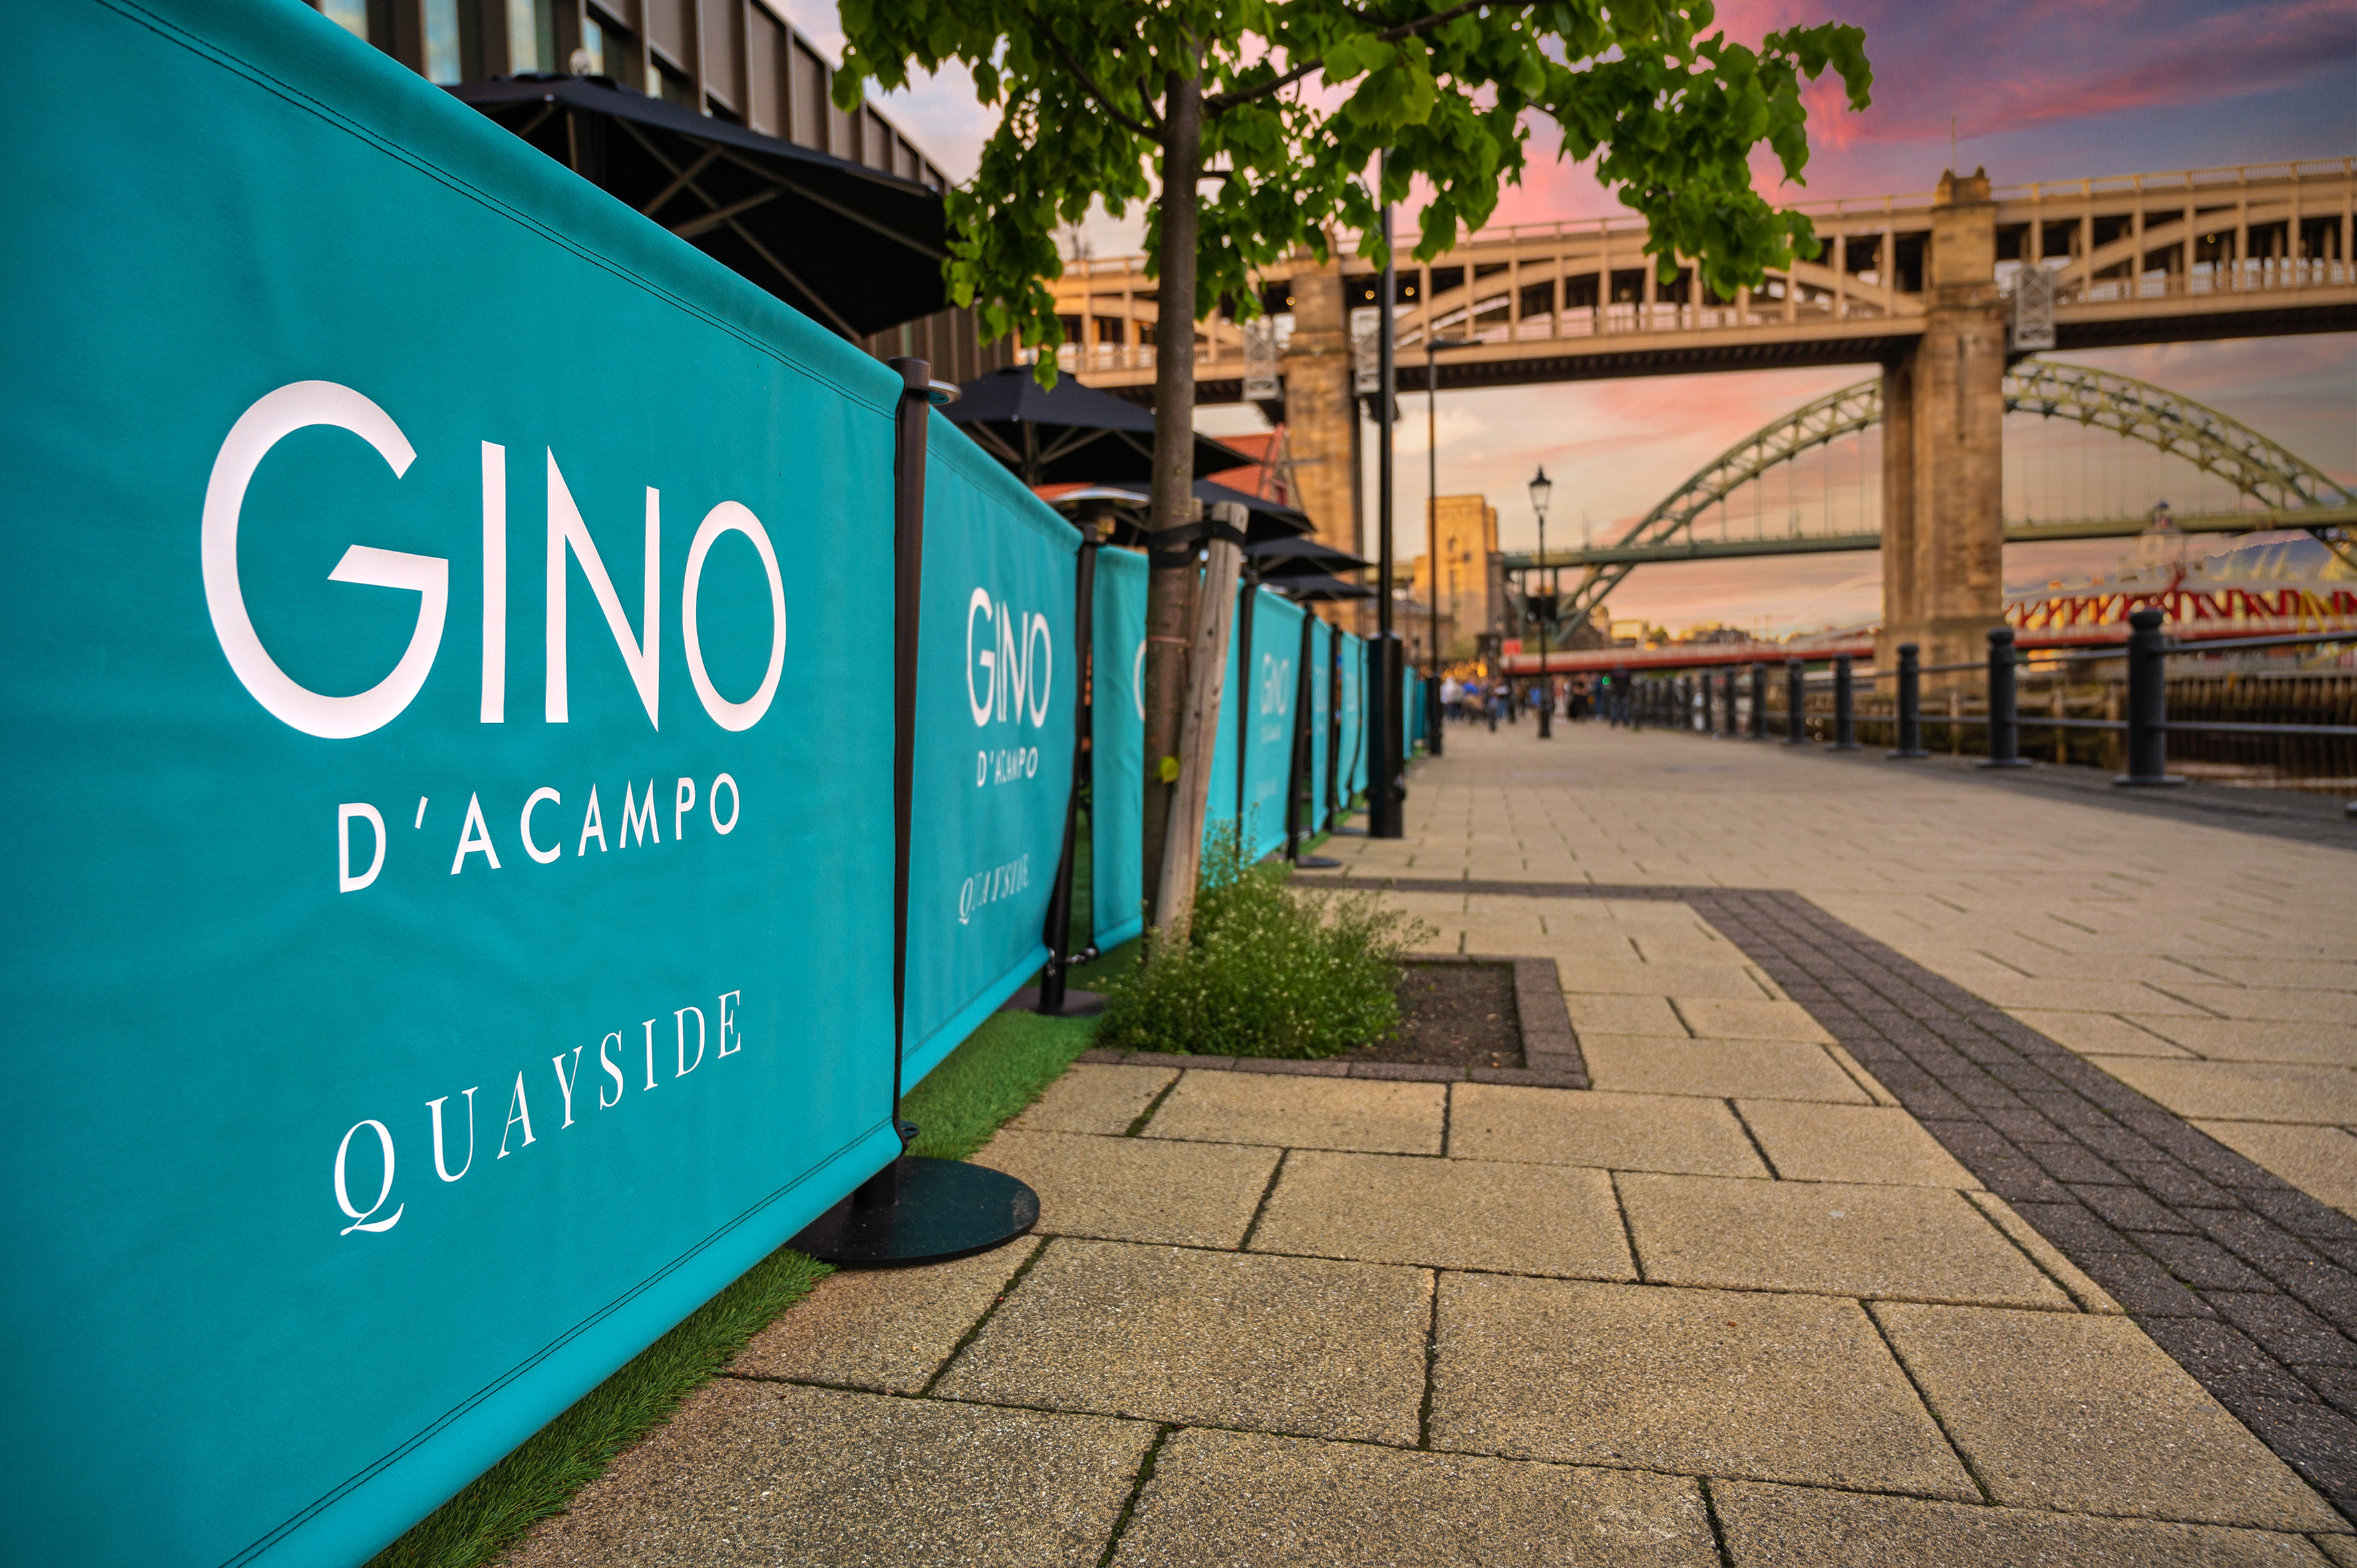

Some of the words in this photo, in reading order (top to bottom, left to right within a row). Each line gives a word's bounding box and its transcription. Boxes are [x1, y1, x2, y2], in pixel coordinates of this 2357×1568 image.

[201, 380, 787, 740] GINO
[966, 587, 1052, 728] GINO
[338, 772, 740, 893] D'ACAMPO
[334, 989, 741, 1236] QUAYSIDE
